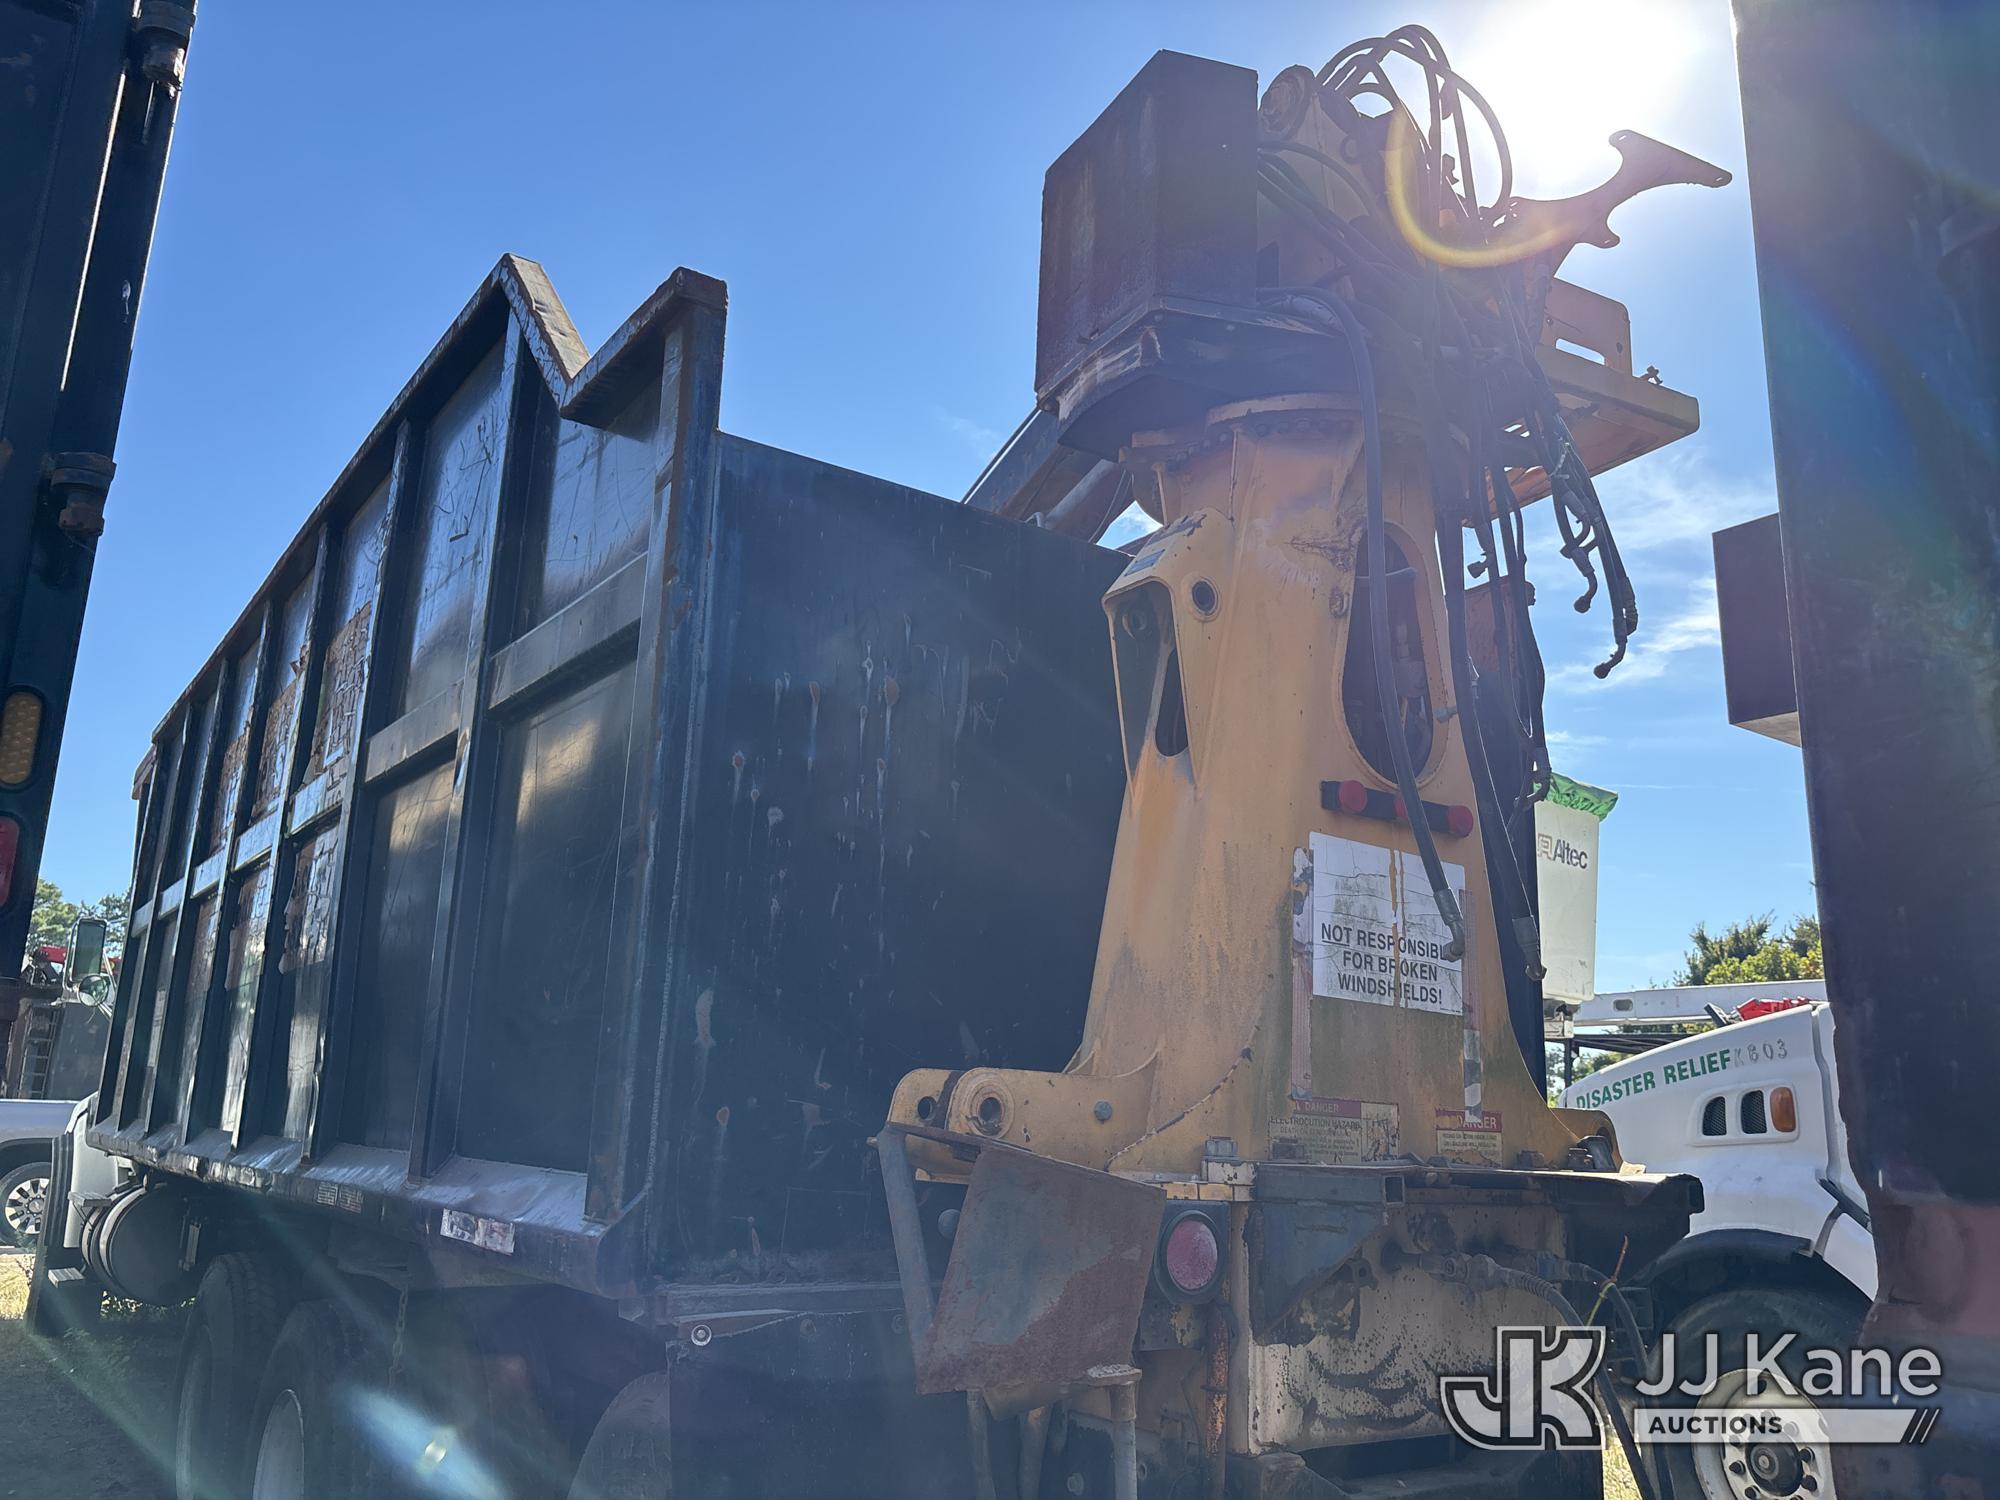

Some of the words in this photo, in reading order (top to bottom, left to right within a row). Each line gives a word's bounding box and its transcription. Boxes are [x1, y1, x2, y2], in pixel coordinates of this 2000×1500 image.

[1553, 839, 1588, 869] Altec
[1321, 922, 1352, 944] NOT
[1357, 929, 1448, 960] RESPONSIBL
[1343, 950, 1373, 972] FOR
[1378, 956, 1437, 981] BROKEN
[1337, 972, 1442, 1005] WINDSHIELDS!
[1576, 1071, 1656, 1109] DISASTER
[1663, 1049, 1731, 1085] RELIEF
[1305, 1102, 1340, 1113] DANGER
